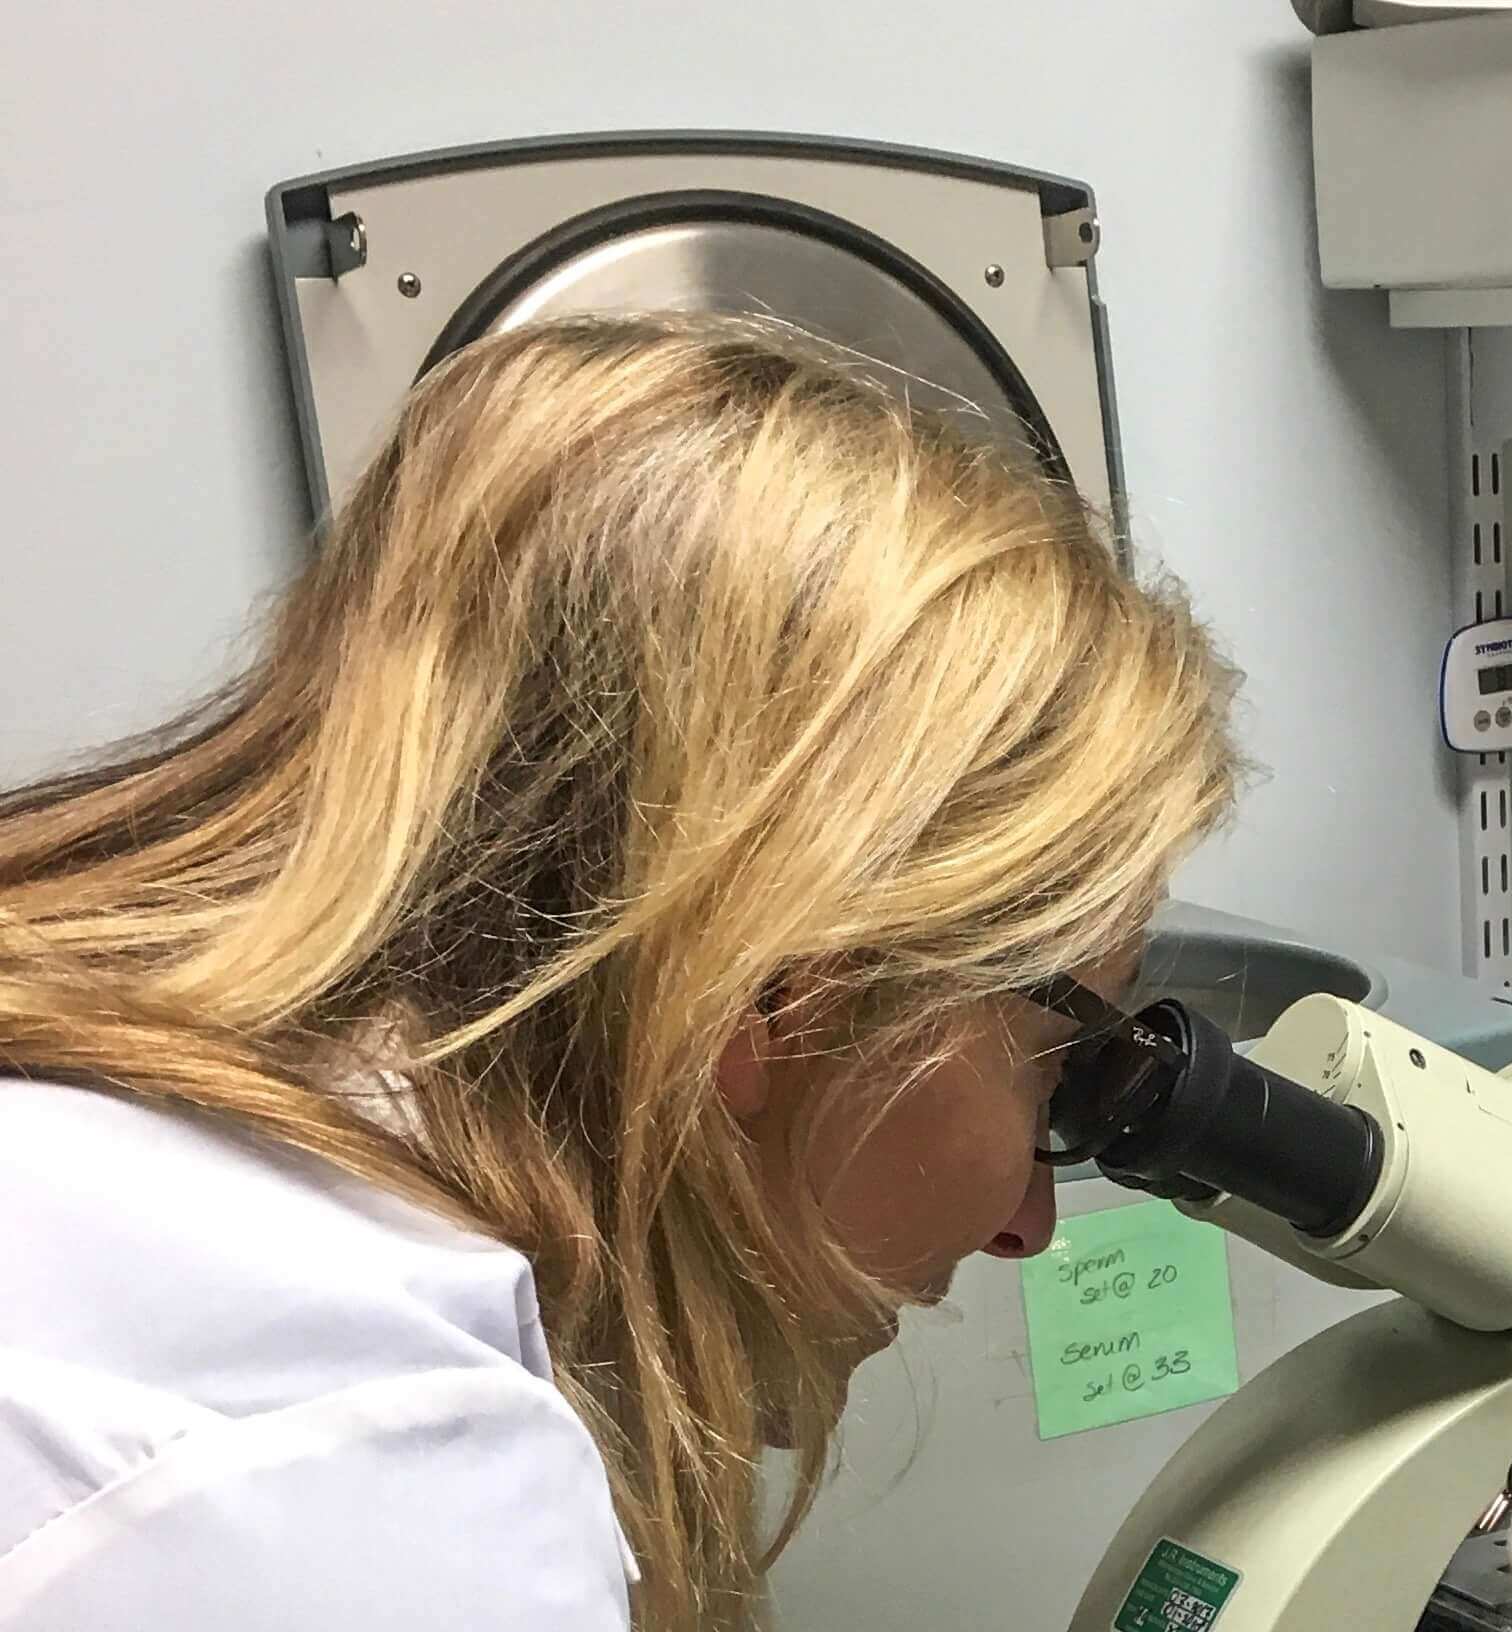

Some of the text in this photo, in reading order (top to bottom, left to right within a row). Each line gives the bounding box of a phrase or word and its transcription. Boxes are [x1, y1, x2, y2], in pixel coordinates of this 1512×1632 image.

[1147, 1264, 1178, 1290] 20
[1121, 1363, 1145, 1392] @
[1151, 1350, 1191, 1381] 33
